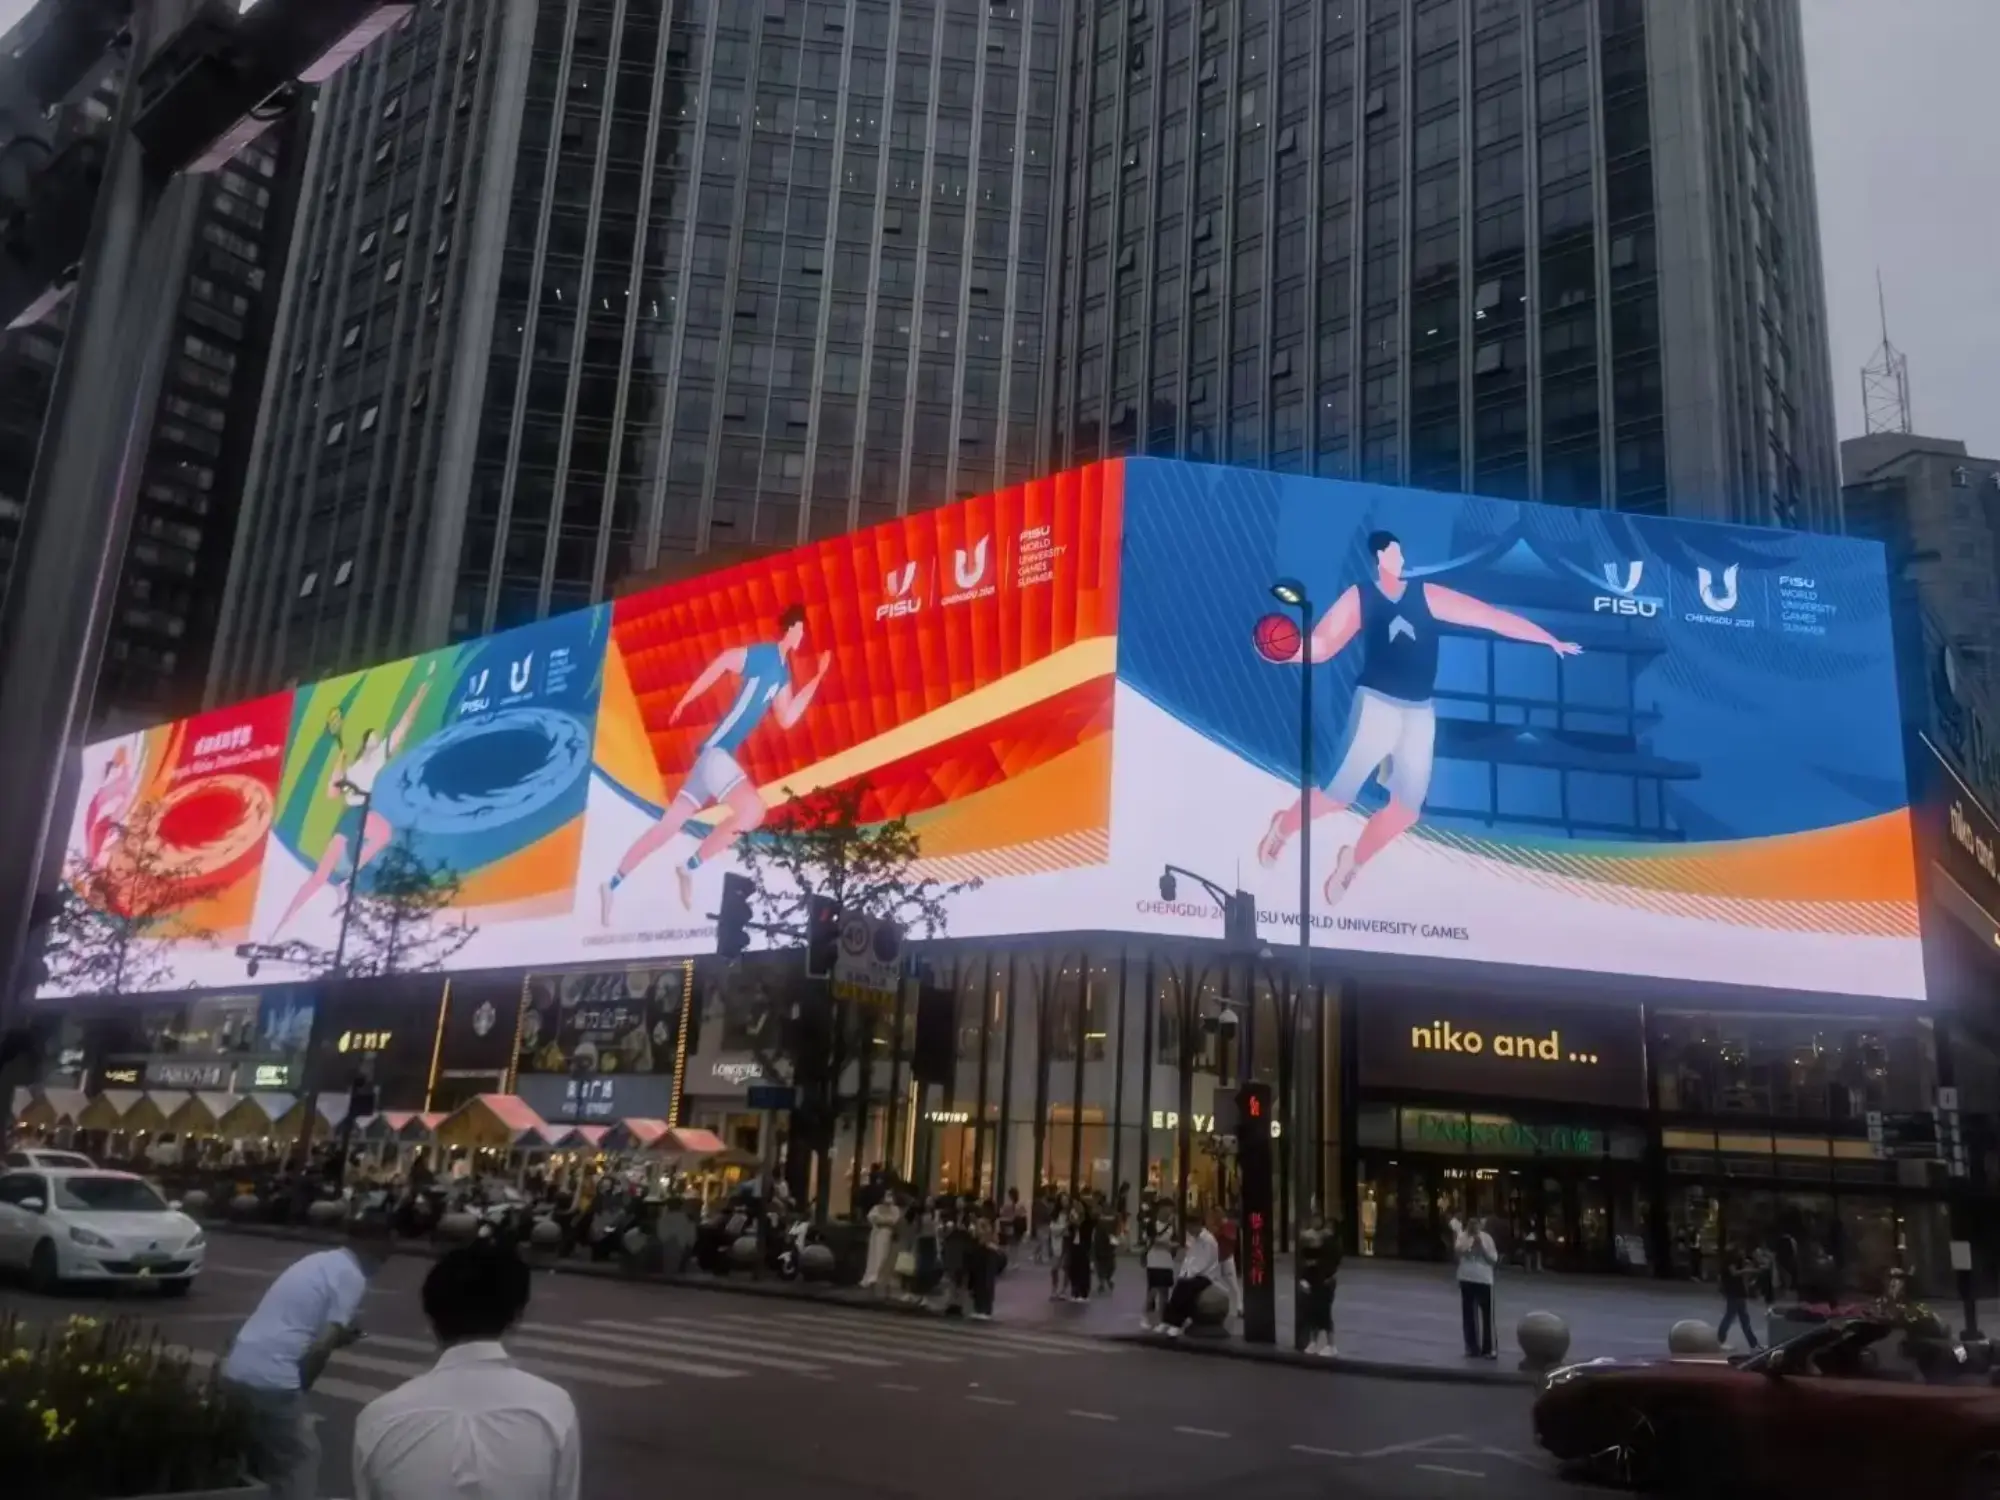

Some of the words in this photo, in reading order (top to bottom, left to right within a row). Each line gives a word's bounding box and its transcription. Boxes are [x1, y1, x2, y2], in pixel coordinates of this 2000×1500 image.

[1019, 526, 1050, 541] FISU
[1020, 538, 1051, 552] WORLD
[1019, 545, 1066, 565] UNIVERSITY
[1018, 561, 1047, 577] GAMES
[1779, 575, 1815, 588] FISU
[1780, 588, 1817, 601] WORLD
[876, 597, 922, 621] FISU
[1593, 596, 1656, 617] FISU
[1781, 600, 1836, 615] UNIVERSITY
[1685, 613, 1732, 626] CHENGDU
[1782, 612, 1816, 624] GAMES
[1136, 900, 1207, 919] CHENGDU
[1255, 909, 1279, 925] ISU
[1337, 917, 1417, 936] UNIVERSITY
[1421, 924, 1469, 941] GAMES
[1411, 1020, 1483, 1054] niko
[1494, 1030, 1559, 1061] and
